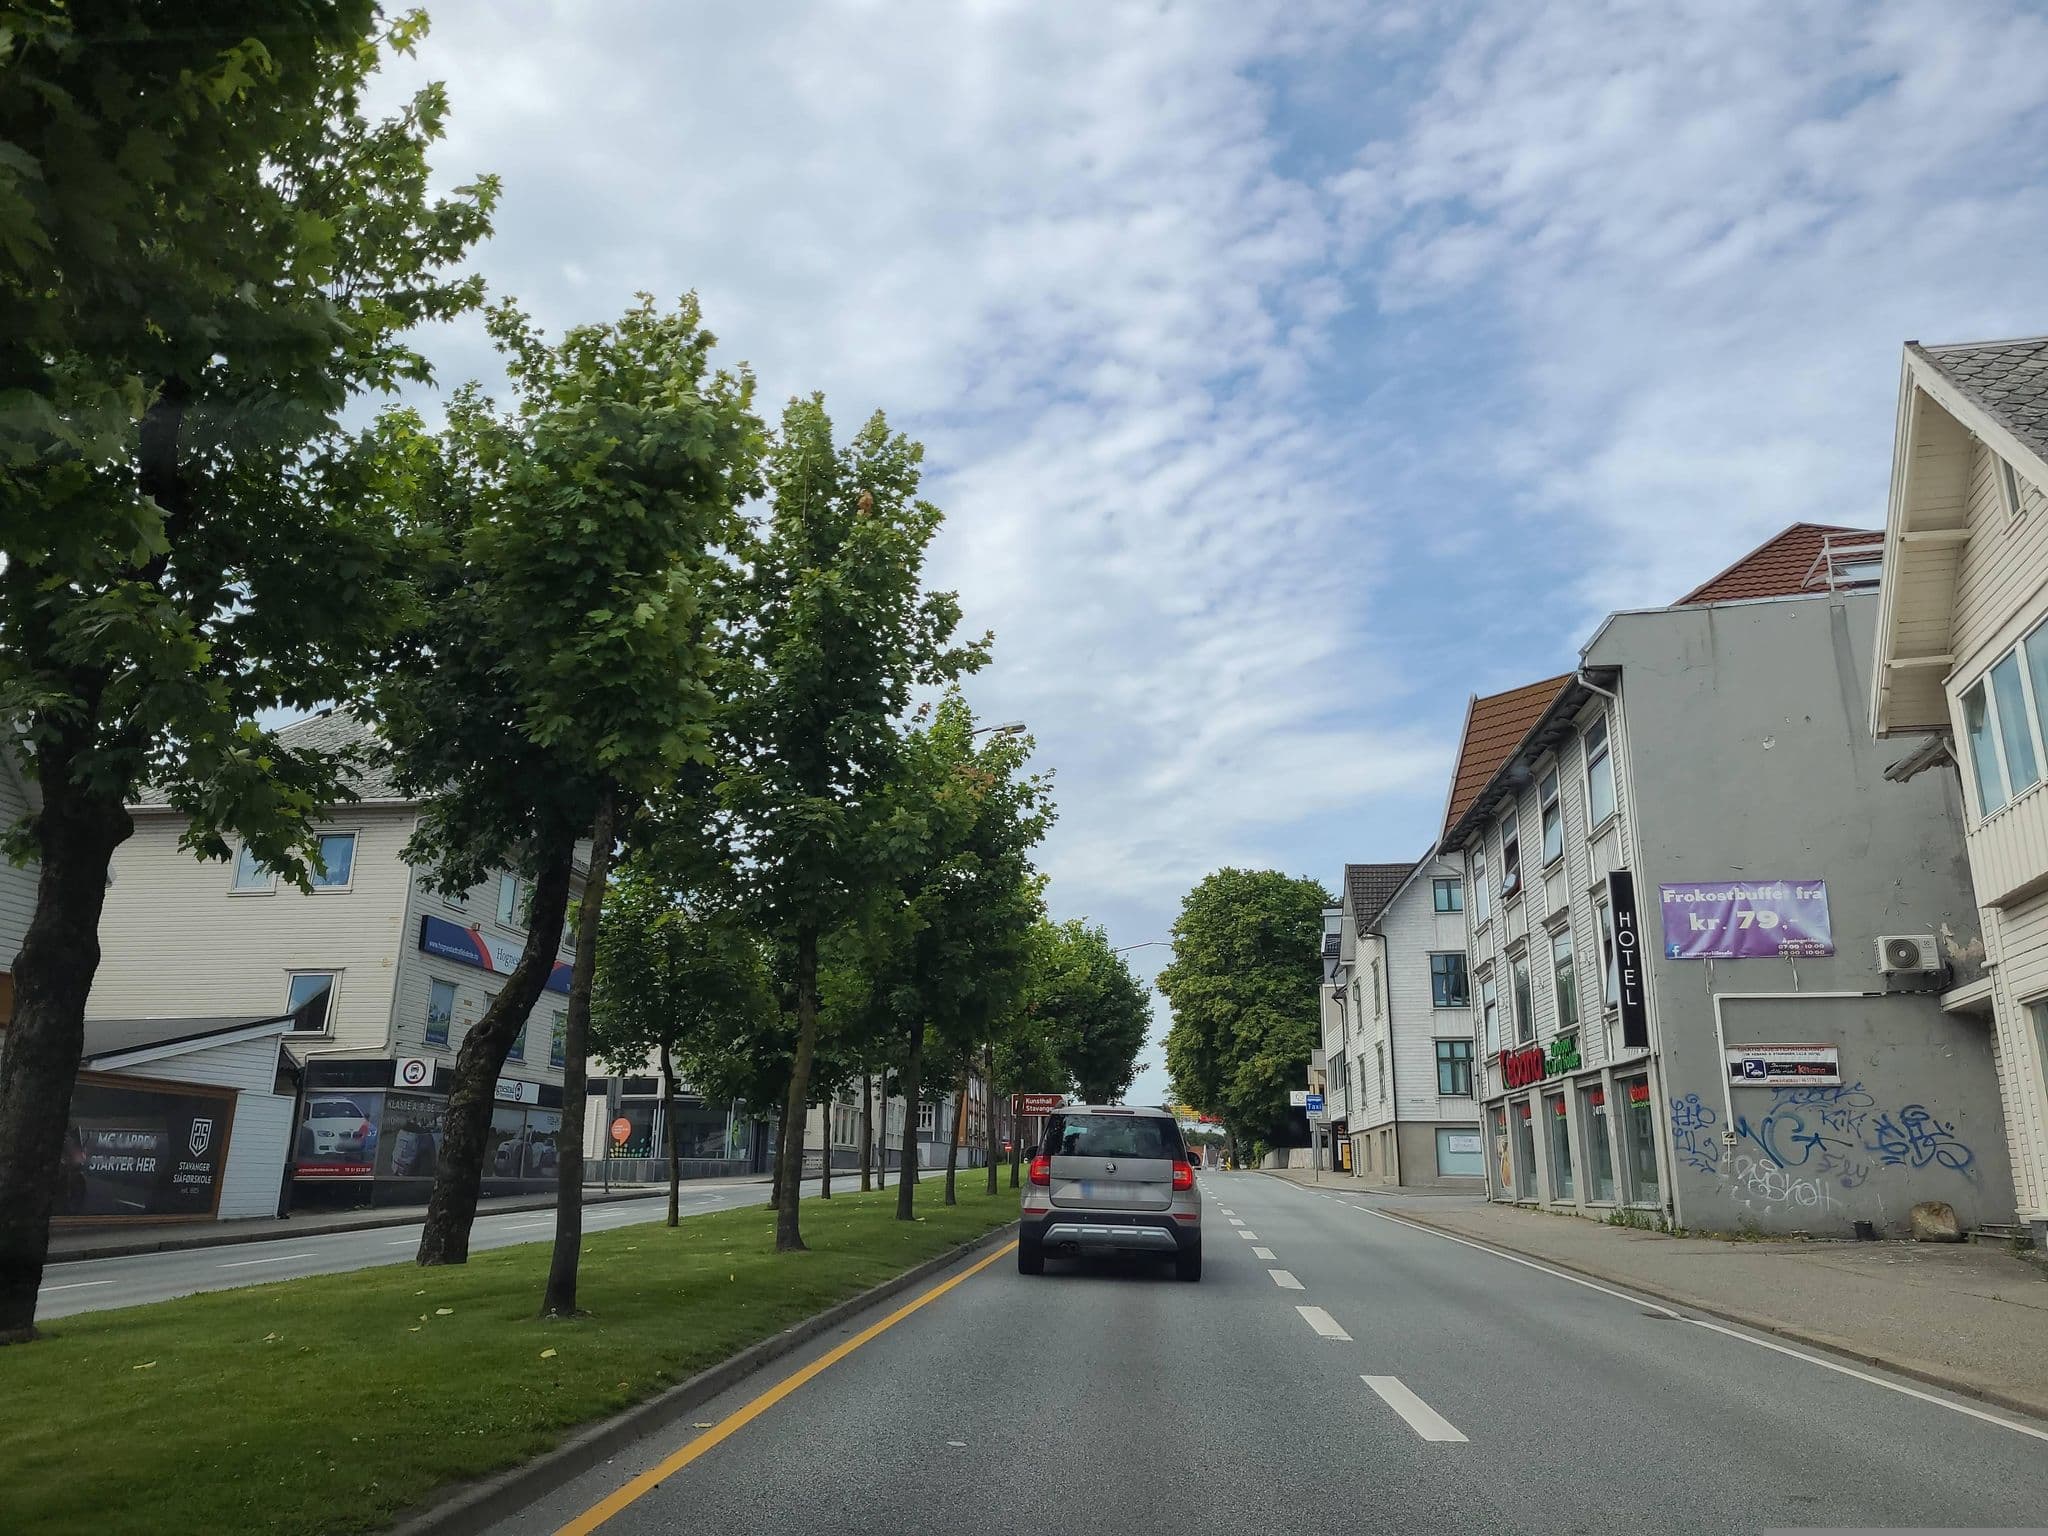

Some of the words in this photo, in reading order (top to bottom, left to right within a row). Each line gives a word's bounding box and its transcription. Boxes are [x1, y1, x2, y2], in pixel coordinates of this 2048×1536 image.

[1796, 886, 1823, 900] fra
[1689, 912, 1728, 931] kr.
[1618, 911, 1638, 1006] HOTEL
[1745, 1062, 1755, 1073] P
[89, 1155, 134, 1172] STARTER
[135, 1156, 156, 1173] HER
[178, 1161, 211, 1172] STAVANGER
